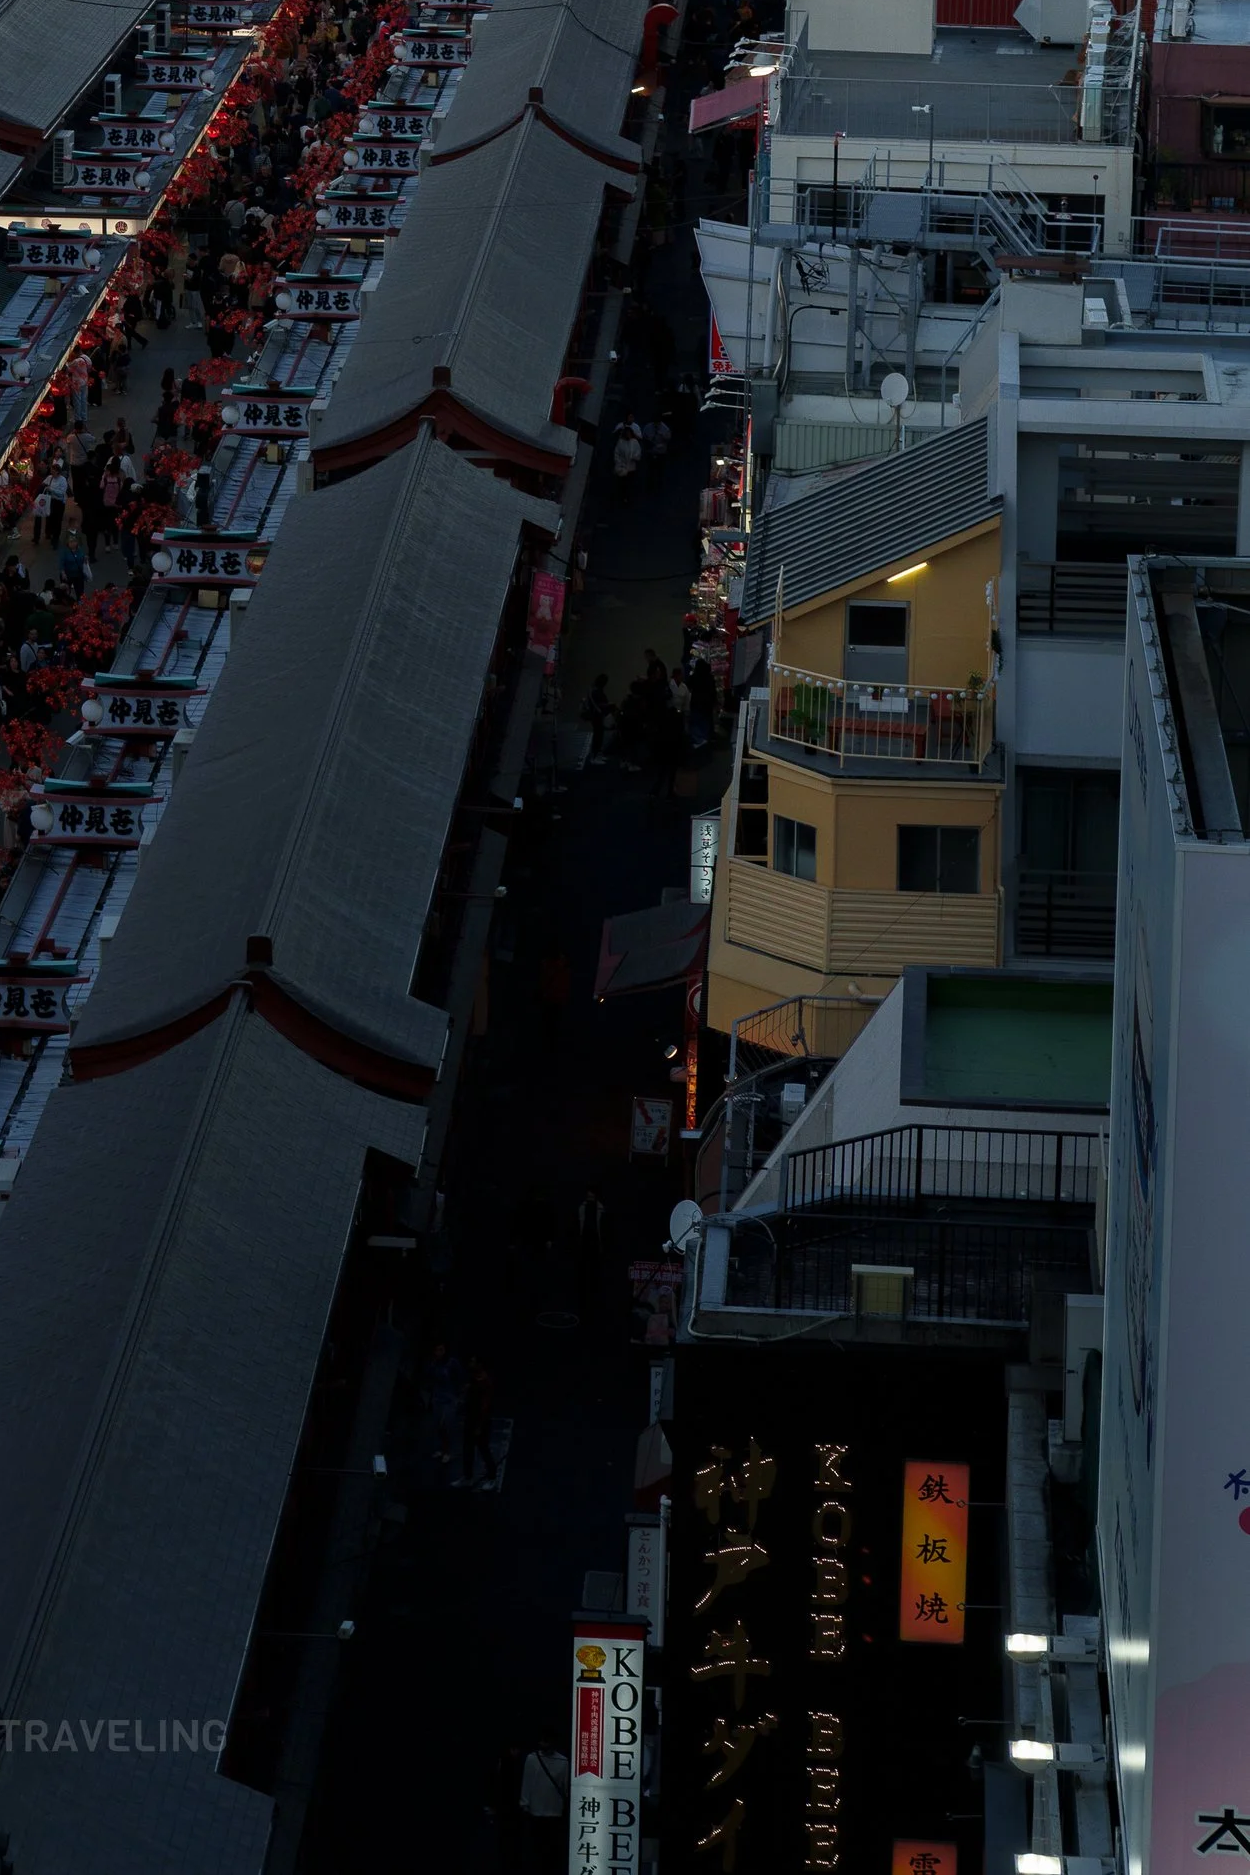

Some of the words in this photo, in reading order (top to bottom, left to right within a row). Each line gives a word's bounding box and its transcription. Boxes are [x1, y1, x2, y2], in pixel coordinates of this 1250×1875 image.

[637, 1530, 651, 1575] とんかつ
[808, 1442, 853, 1663] KOBE
[914, 1473, 955, 1624] 鉄板焼
[609, 1647, 640, 1781] KOBE
[608, 1797, 637, 1875] BE
